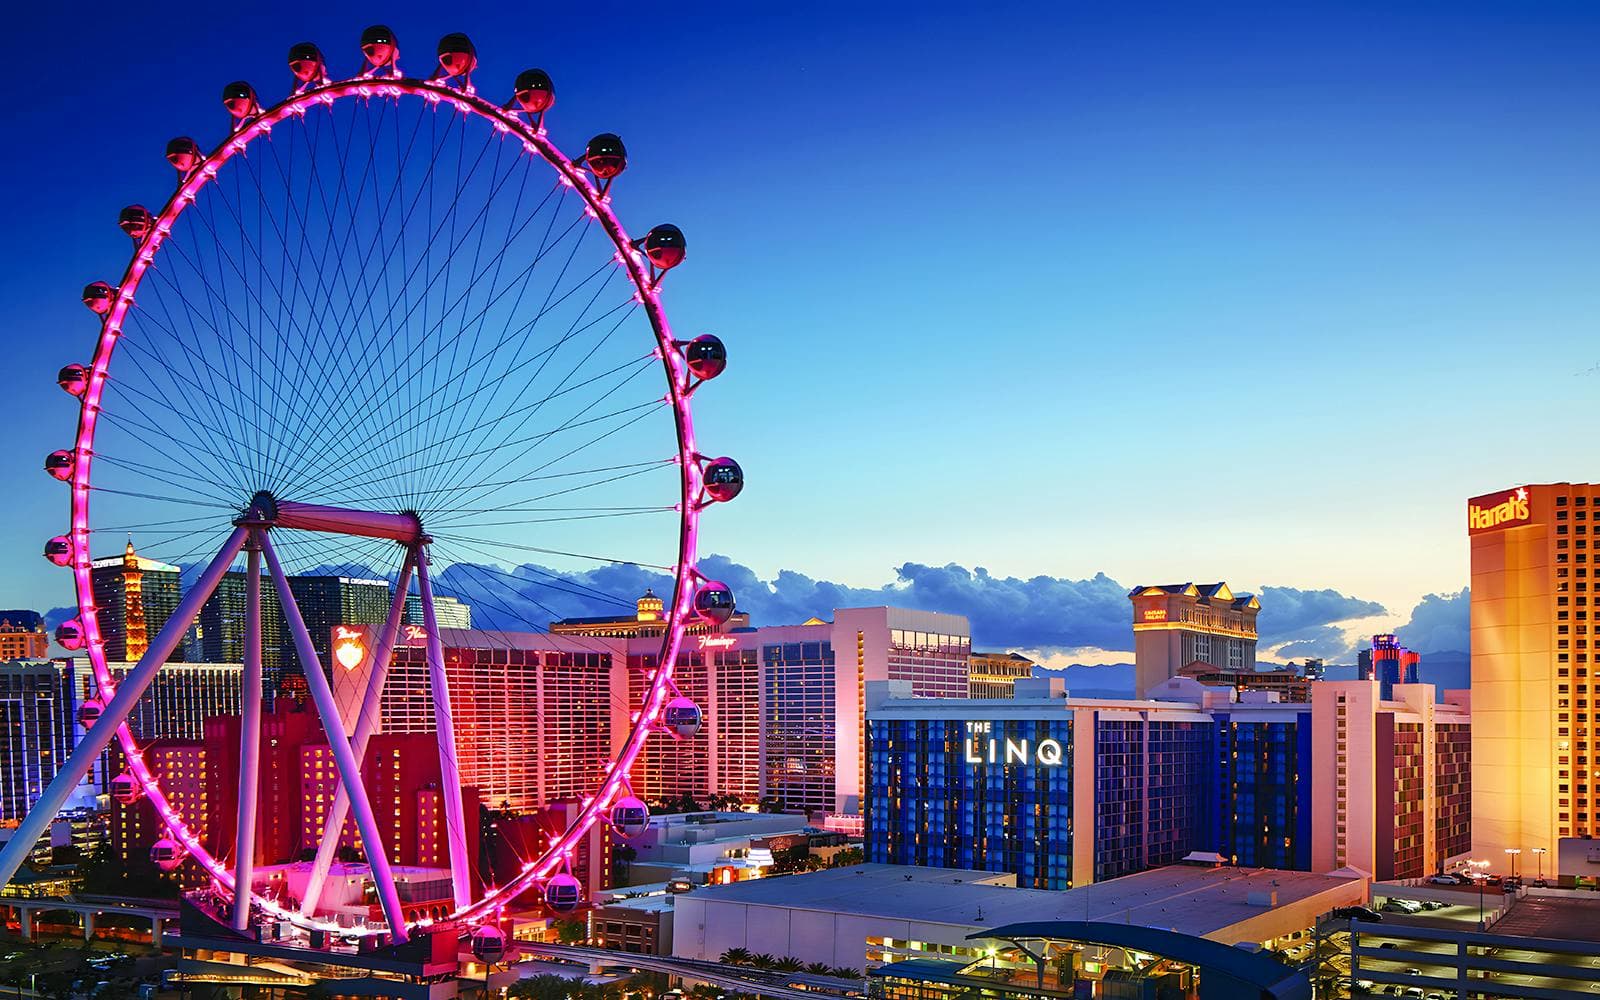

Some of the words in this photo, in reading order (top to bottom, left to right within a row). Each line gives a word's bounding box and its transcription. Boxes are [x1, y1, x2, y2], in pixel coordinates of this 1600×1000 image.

[1469, 491, 1530, 529] Harrah's
[698, 634, 737, 650] Flamingo
[966, 721, 991, 733] THE
[965, 737, 1063, 766] LINQ
